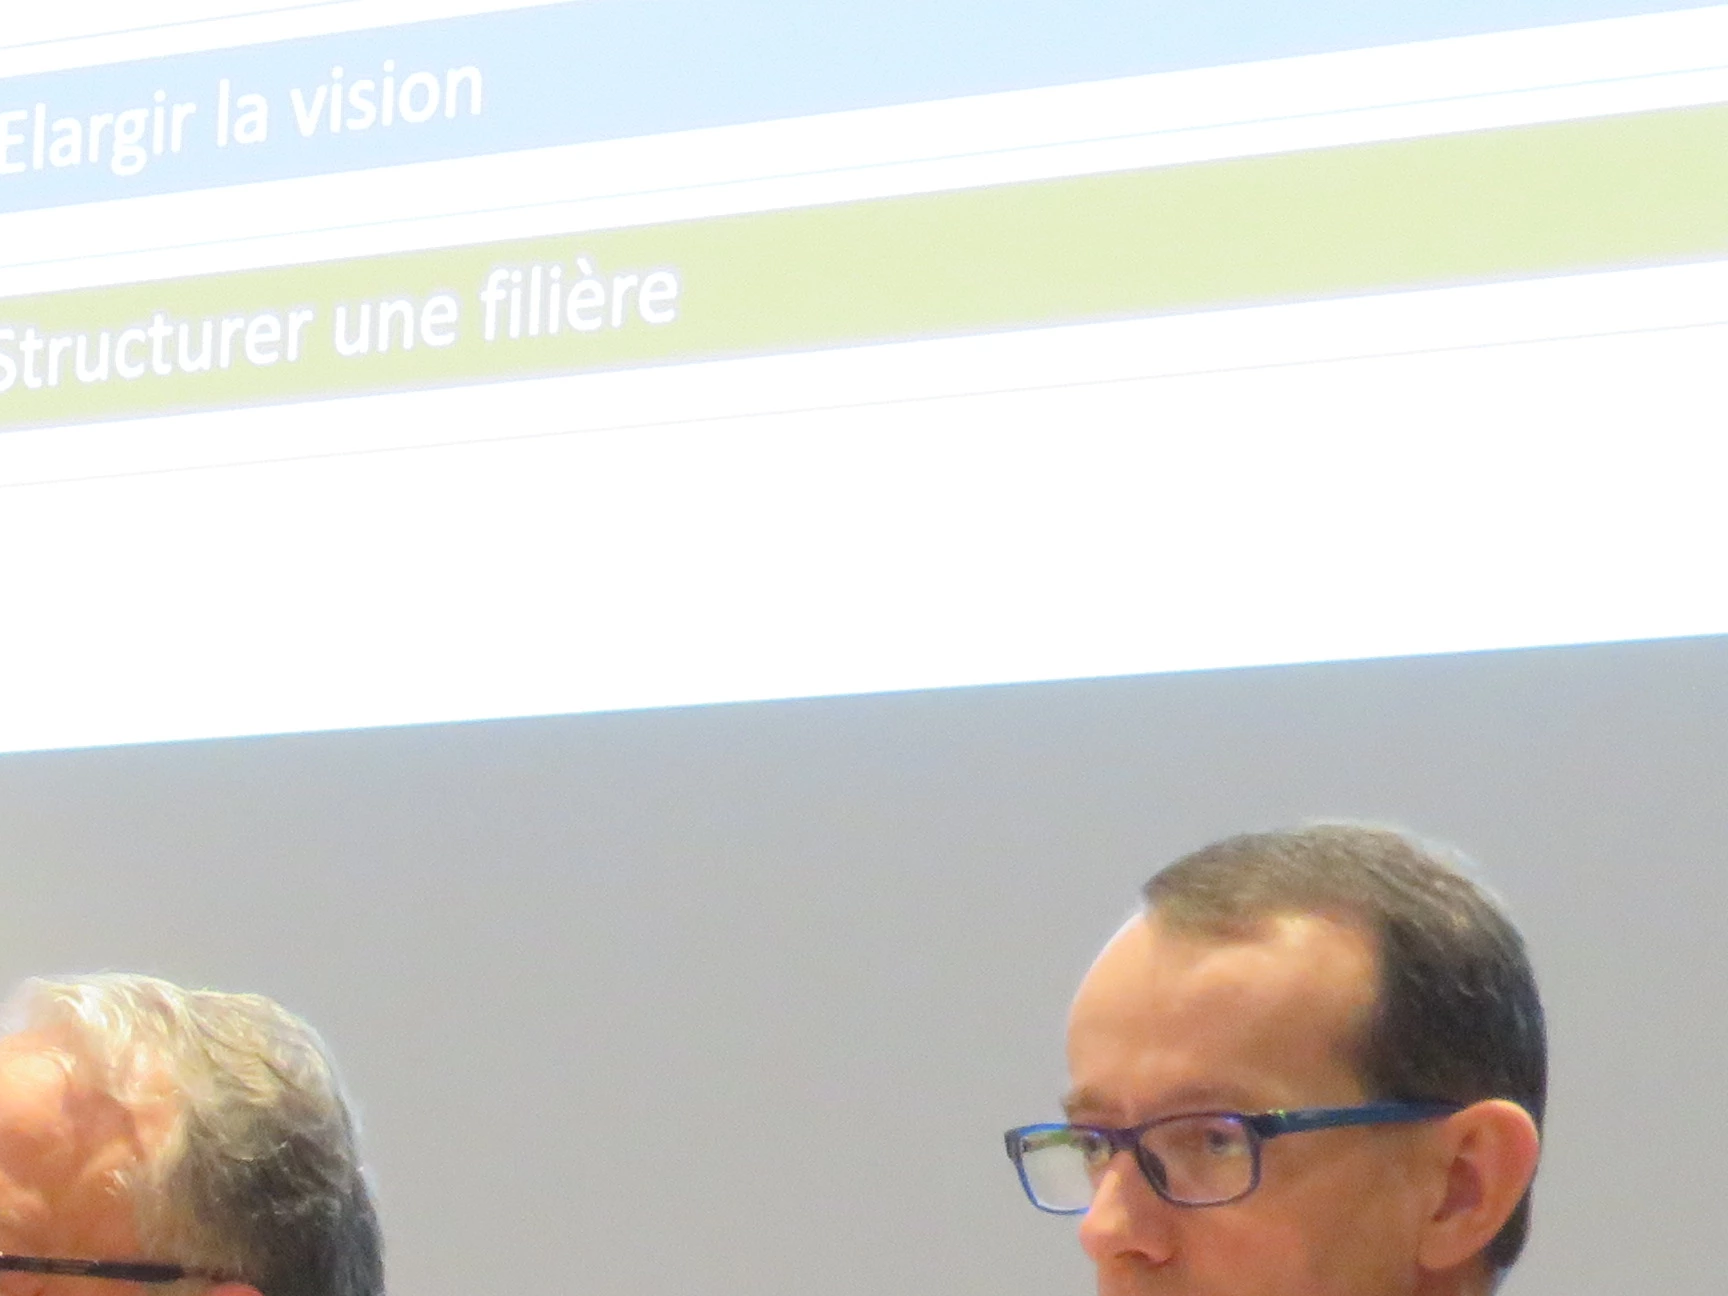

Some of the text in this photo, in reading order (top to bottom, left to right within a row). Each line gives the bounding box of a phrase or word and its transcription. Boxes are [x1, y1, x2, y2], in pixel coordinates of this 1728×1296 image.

[217, 78, 269, 147] la
[289, 60, 484, 138] vision
[334, 291, 459, 357] une
[481, 258, 679, 342] filière
